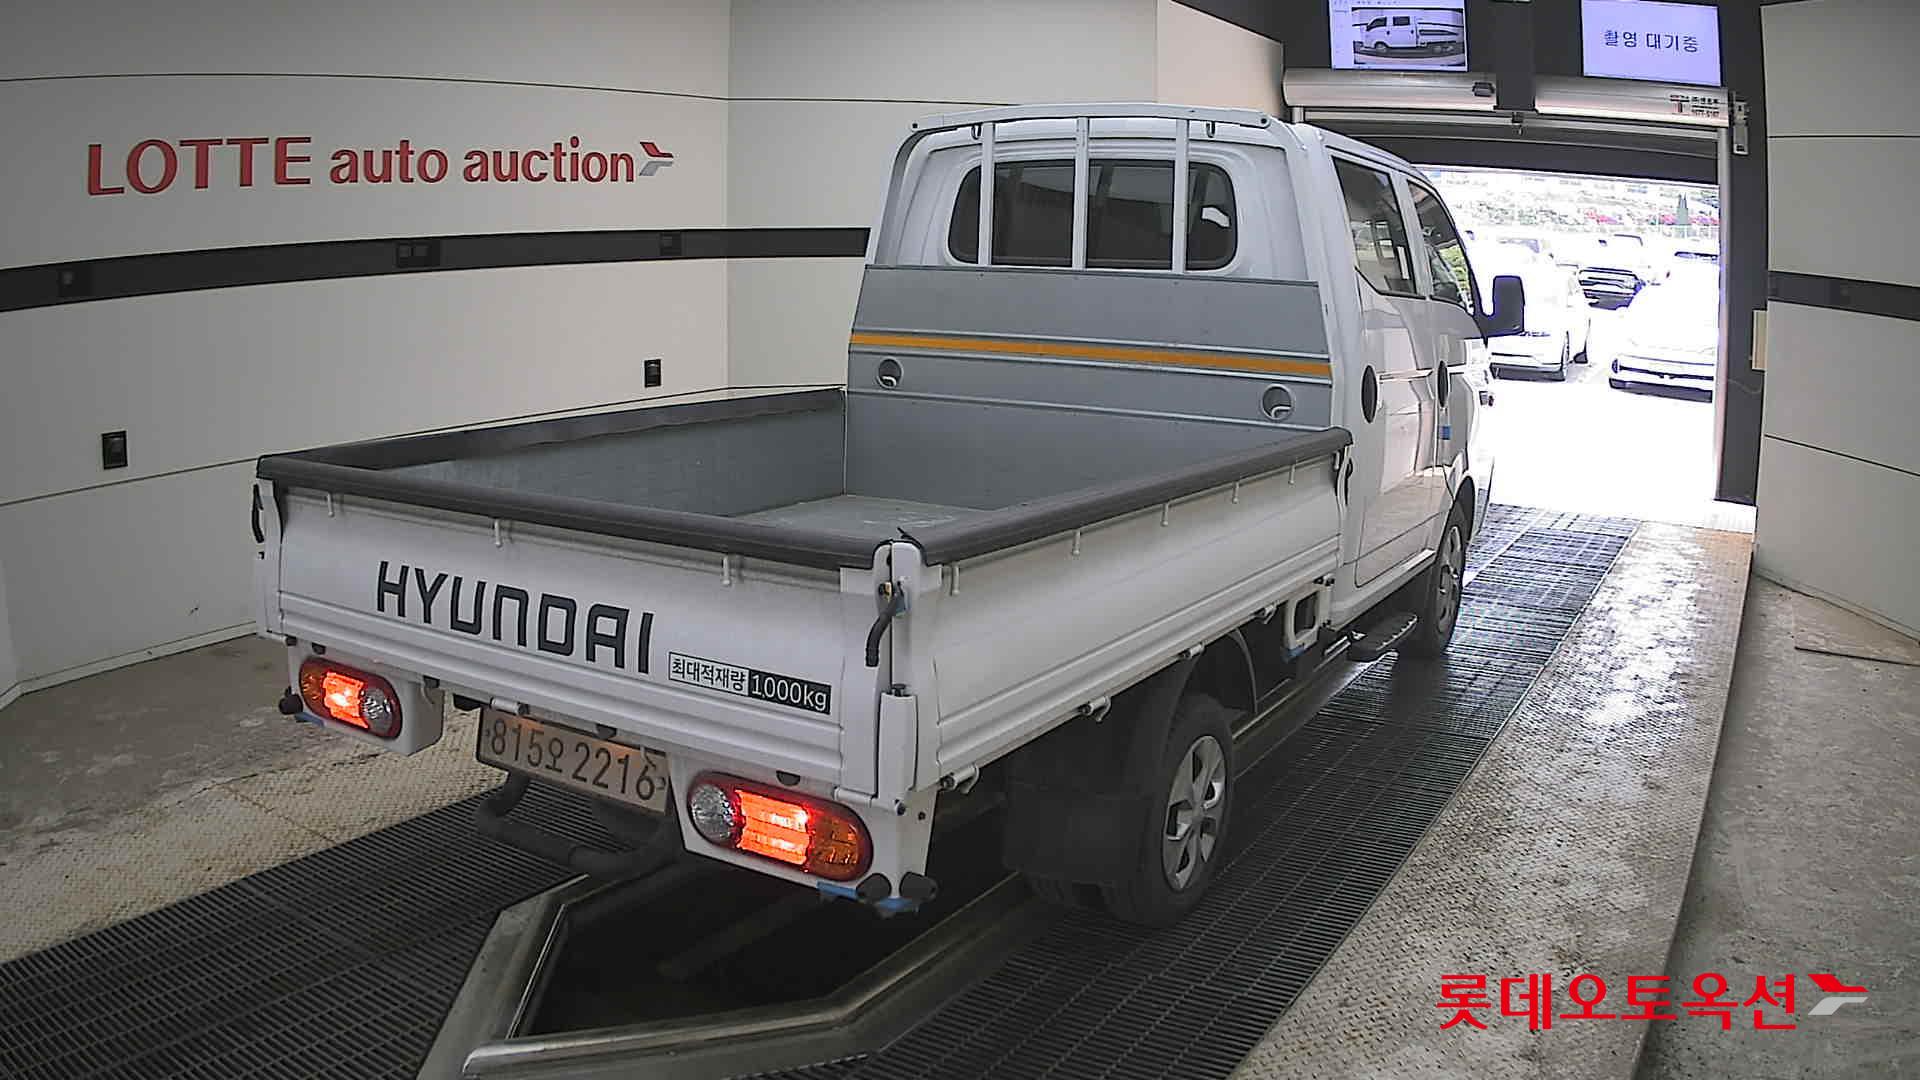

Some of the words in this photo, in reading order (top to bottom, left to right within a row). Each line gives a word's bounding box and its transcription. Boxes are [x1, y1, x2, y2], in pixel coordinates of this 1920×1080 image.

[1646, 33, 1698, 53] 대기중
[88, 137, 312, 196] LOTTE
[330, 139, 448, 184] auto
[463, 136, 635, 183] auction
[377, 561, 654, 674] HYUNDAI
[672, 658, 746, 692] 최대적재량
[571, 742, 655, 800] 2216
